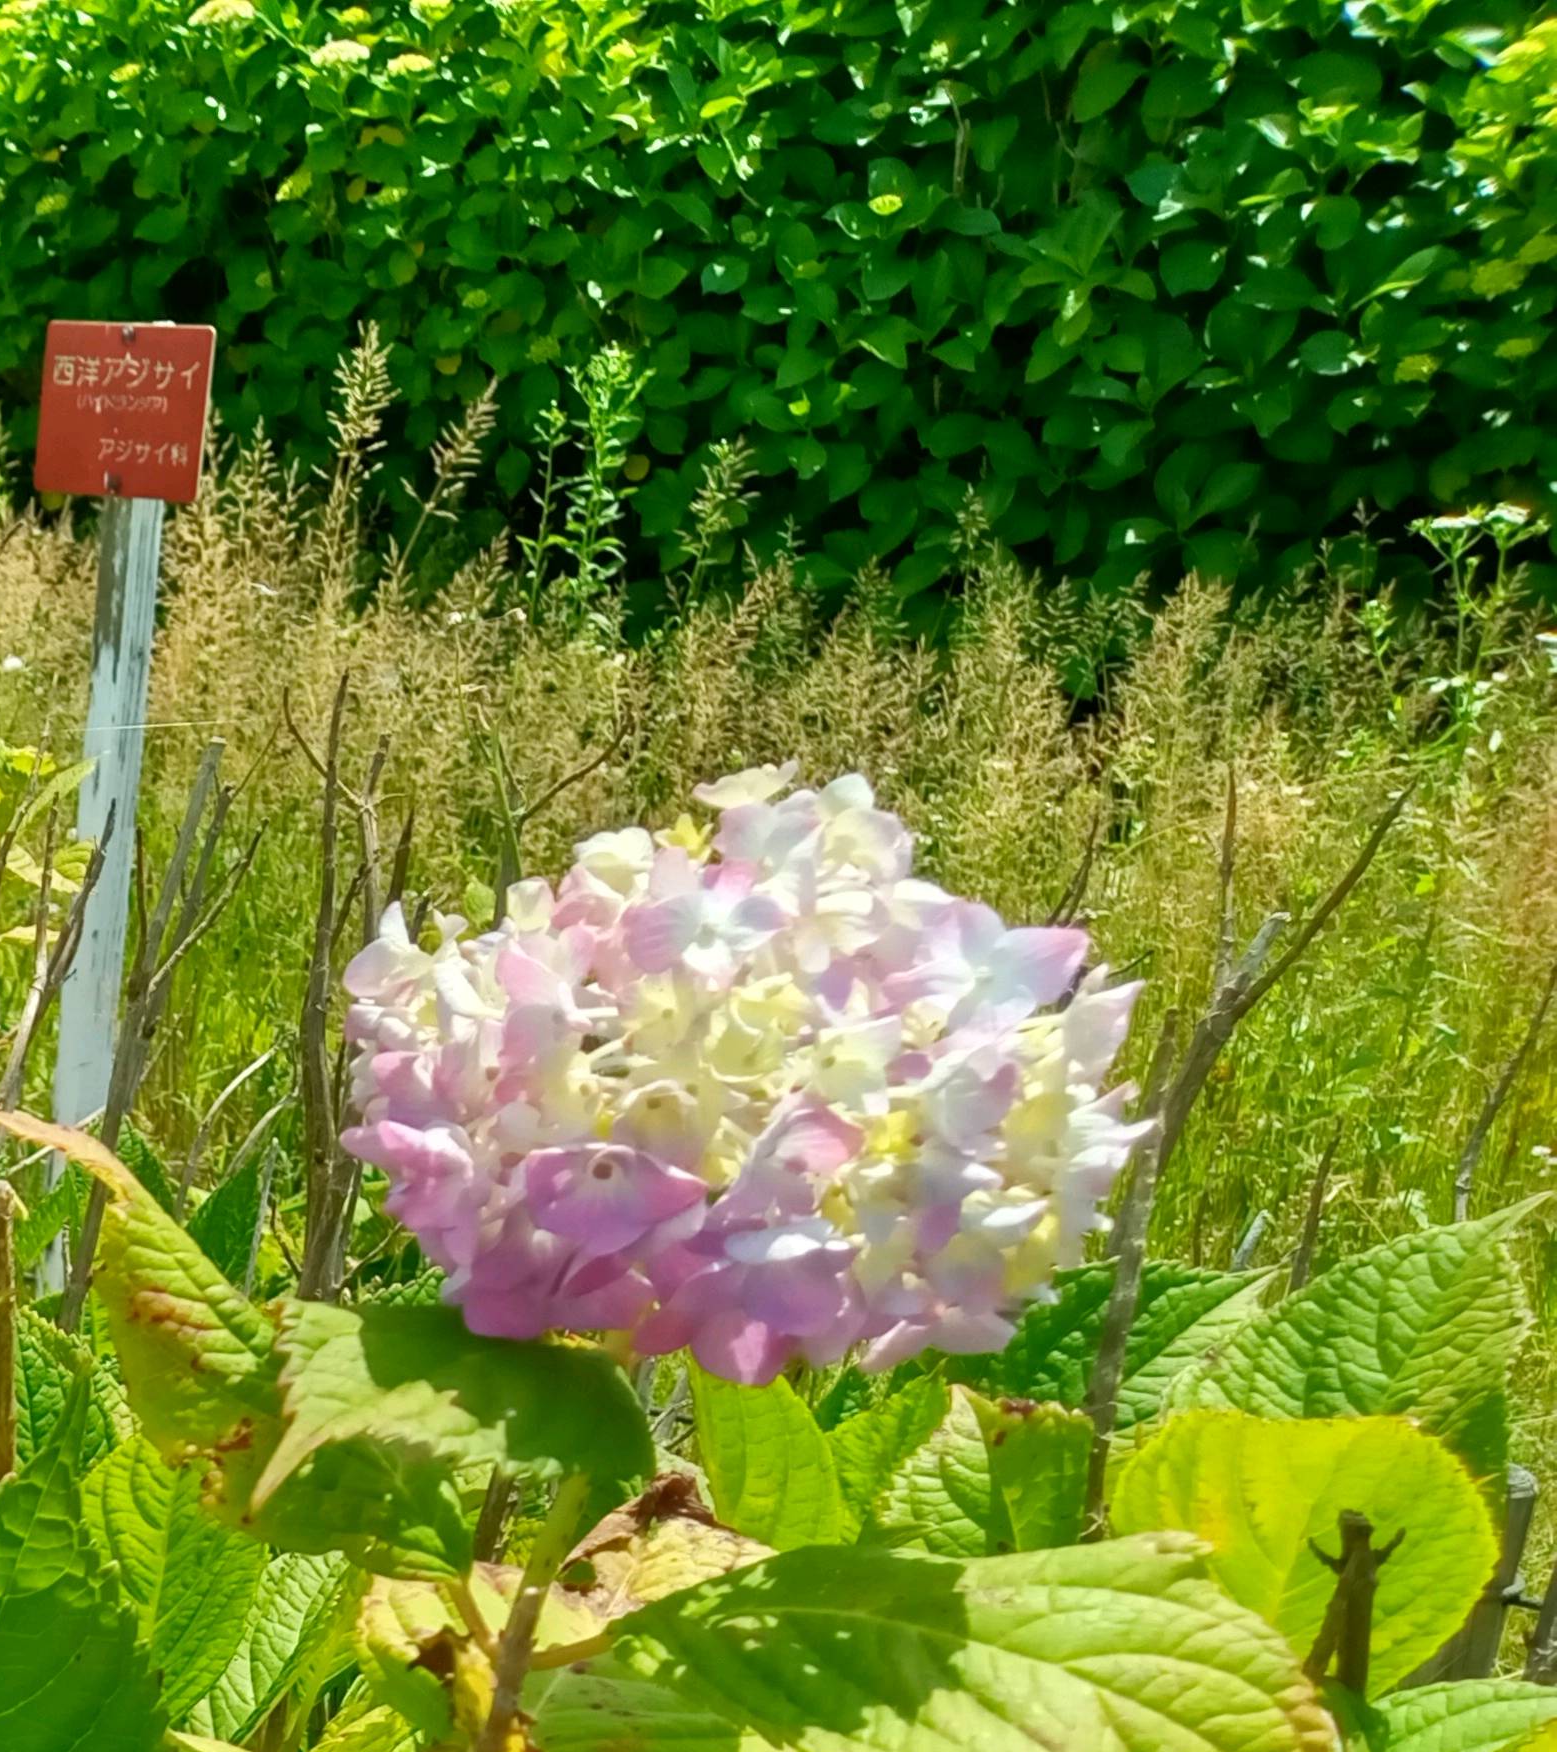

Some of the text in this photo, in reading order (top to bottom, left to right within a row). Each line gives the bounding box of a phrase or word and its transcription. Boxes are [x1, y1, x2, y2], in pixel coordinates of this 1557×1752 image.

[52, 353, 201, 389] 西洋アジサイ
[97, 438, 189, 466] アジサイ科
